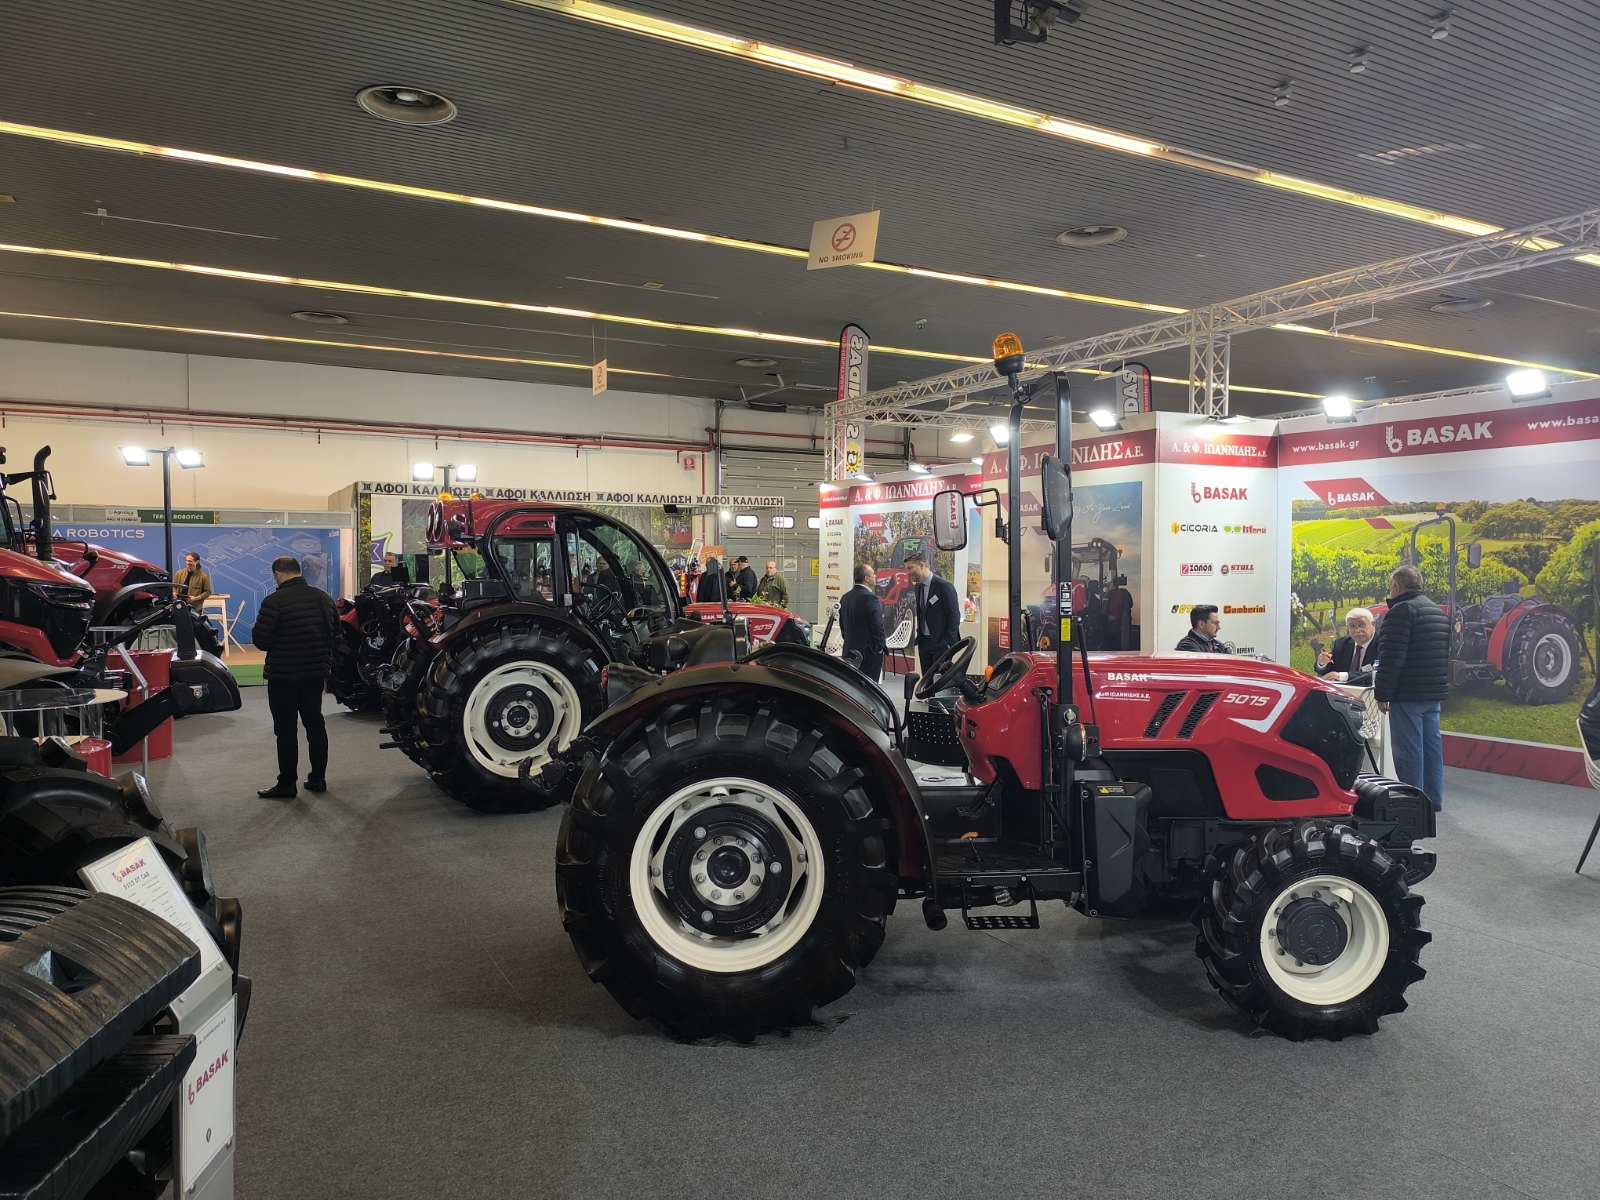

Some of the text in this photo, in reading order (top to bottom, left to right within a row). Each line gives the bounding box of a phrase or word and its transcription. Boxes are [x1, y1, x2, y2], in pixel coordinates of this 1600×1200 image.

[1407, 421, 1493, 446] BASAK
[1292, 440, 1360, 453] www.basak.gr
[375, 483, 408, 494] ΑΦΟΙ
[496, 488, 591, 501] ΑΦΟΙ ΚΑΛΛΙΩΣΗ
[1204, 486, 1248, 501] BASAK
[606, 493, 692, 504] ΑΦΟΙ ΚΑΛΛΙΩΣΗ
[705, 496, 783, 506] ΑΦΟΙ ΚΑΛΛΙΩΣΗ
[1337, 491, 1375, 503] BASAK
[66, 528, 144, 539] ROBOTICS
[1180, 524, 1218, 533] CICORIA
[1107, 672, 1148, 682] BASAK
[1223, 693, 1270, 707] 5075
[120, 858, 146, 878] BASAK
[196, 1049, 229, 1094] BASAK
